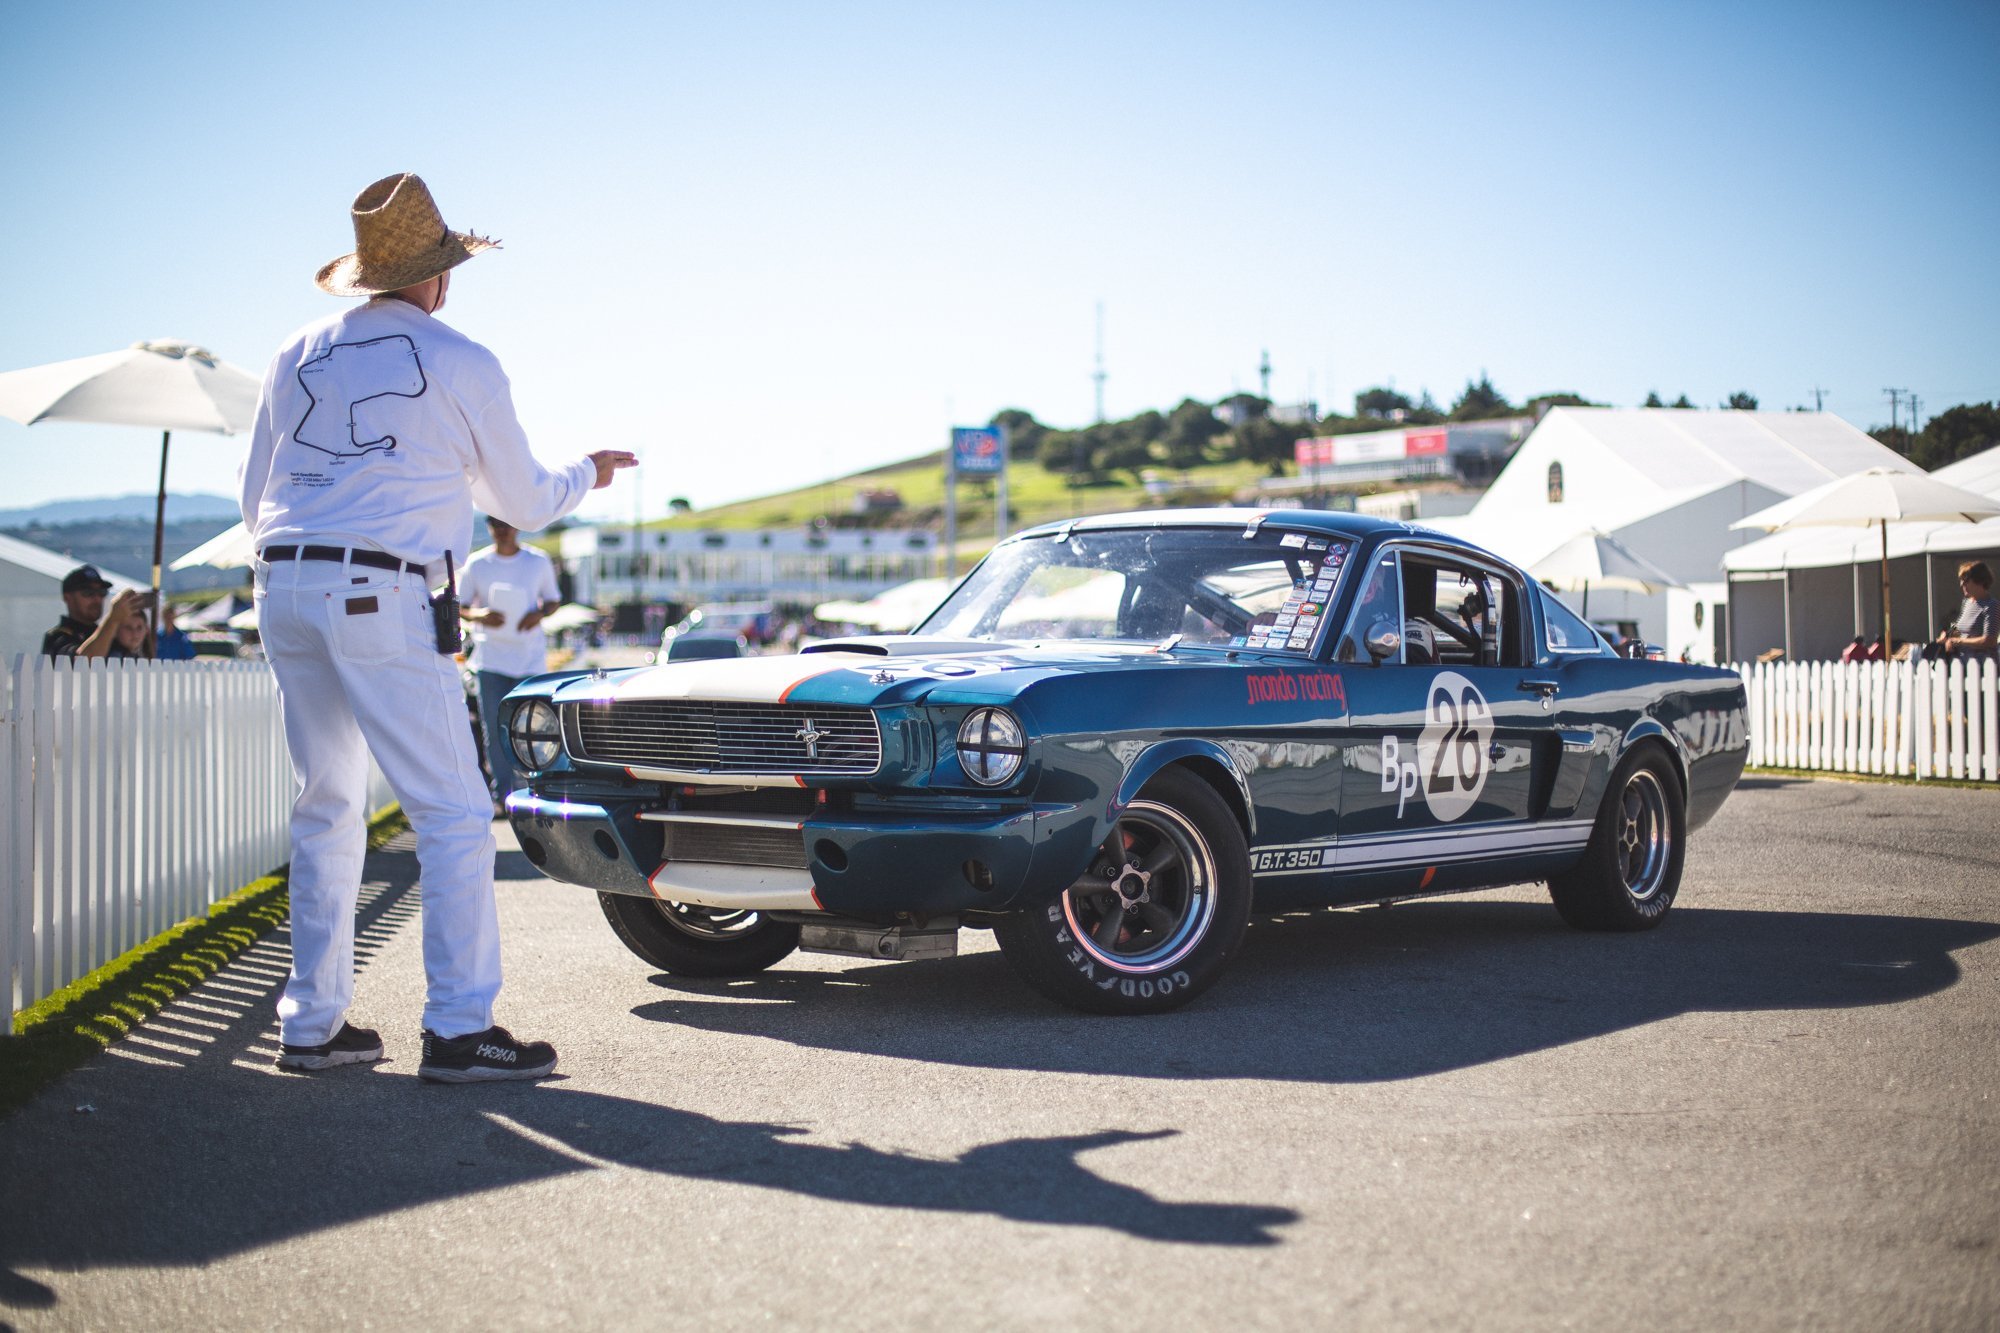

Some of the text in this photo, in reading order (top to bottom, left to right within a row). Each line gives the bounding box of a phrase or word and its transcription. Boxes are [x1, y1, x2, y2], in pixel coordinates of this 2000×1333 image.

[1247, 667, 1345, 711] mondo racing
[1427, 686, 1485, 794] 26
[1381, 735, 1418, 819] Bp
[476, 1043, 517, 1063] HOKA
